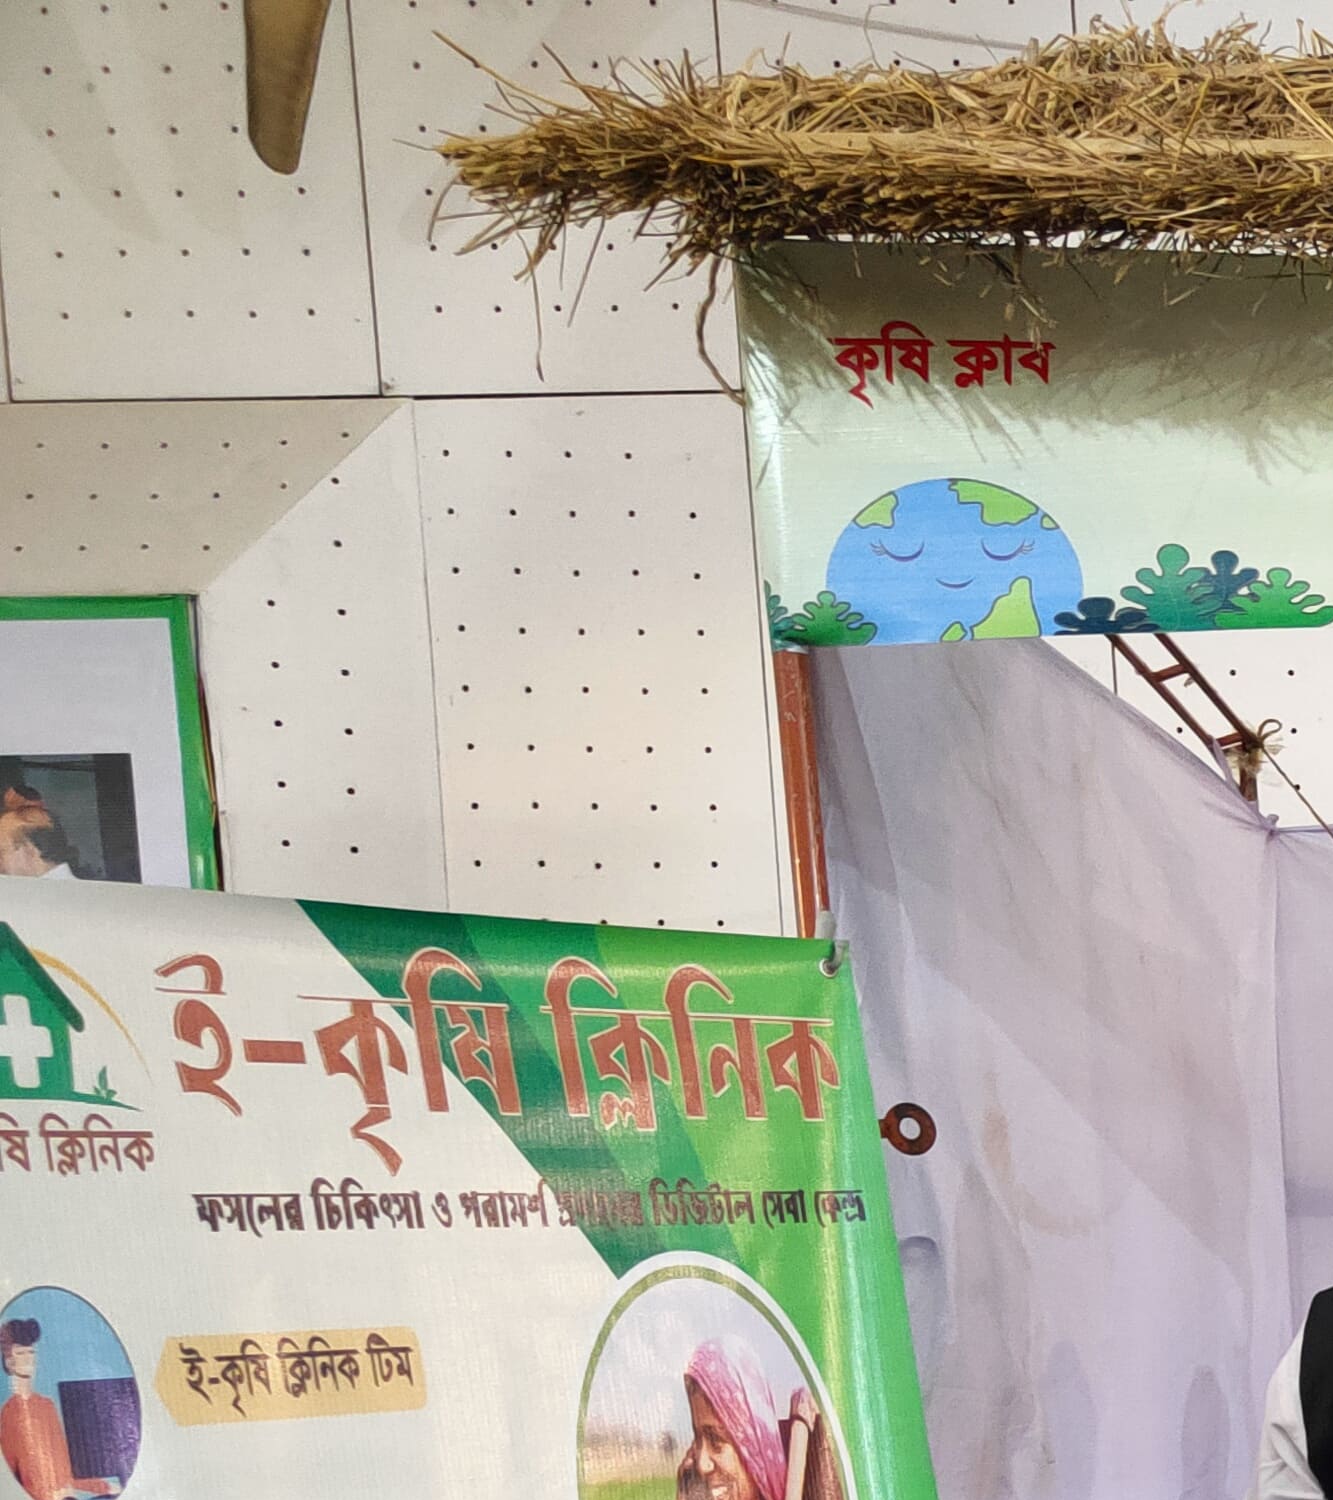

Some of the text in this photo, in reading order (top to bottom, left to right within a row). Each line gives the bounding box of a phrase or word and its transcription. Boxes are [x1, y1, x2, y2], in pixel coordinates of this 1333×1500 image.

[831, 320, 1056, 408] কৃষি ক্লাব
[154, 946, 842, 1177] ই-কৃষি ক্লিনিক
[40, 1115, 155, 1173] ক্লিনিক
[191, 1192, 305, 1238] ফসলের
[308, 1176, 425, 1231] চিকিৎসা
[431, 1191, 453, 1229] ও
[458, 1177, 549, 1229] পরামর্শ
[648, 1176, 756, 1228] ডিজিটাল
[761, 1188, 808, 1230] সেবা
[814, 1188, 867, 1228] কেন্দ্র
[177, 1333, 416, 1417] ই-কৃষি ক্লিনিক টিম
